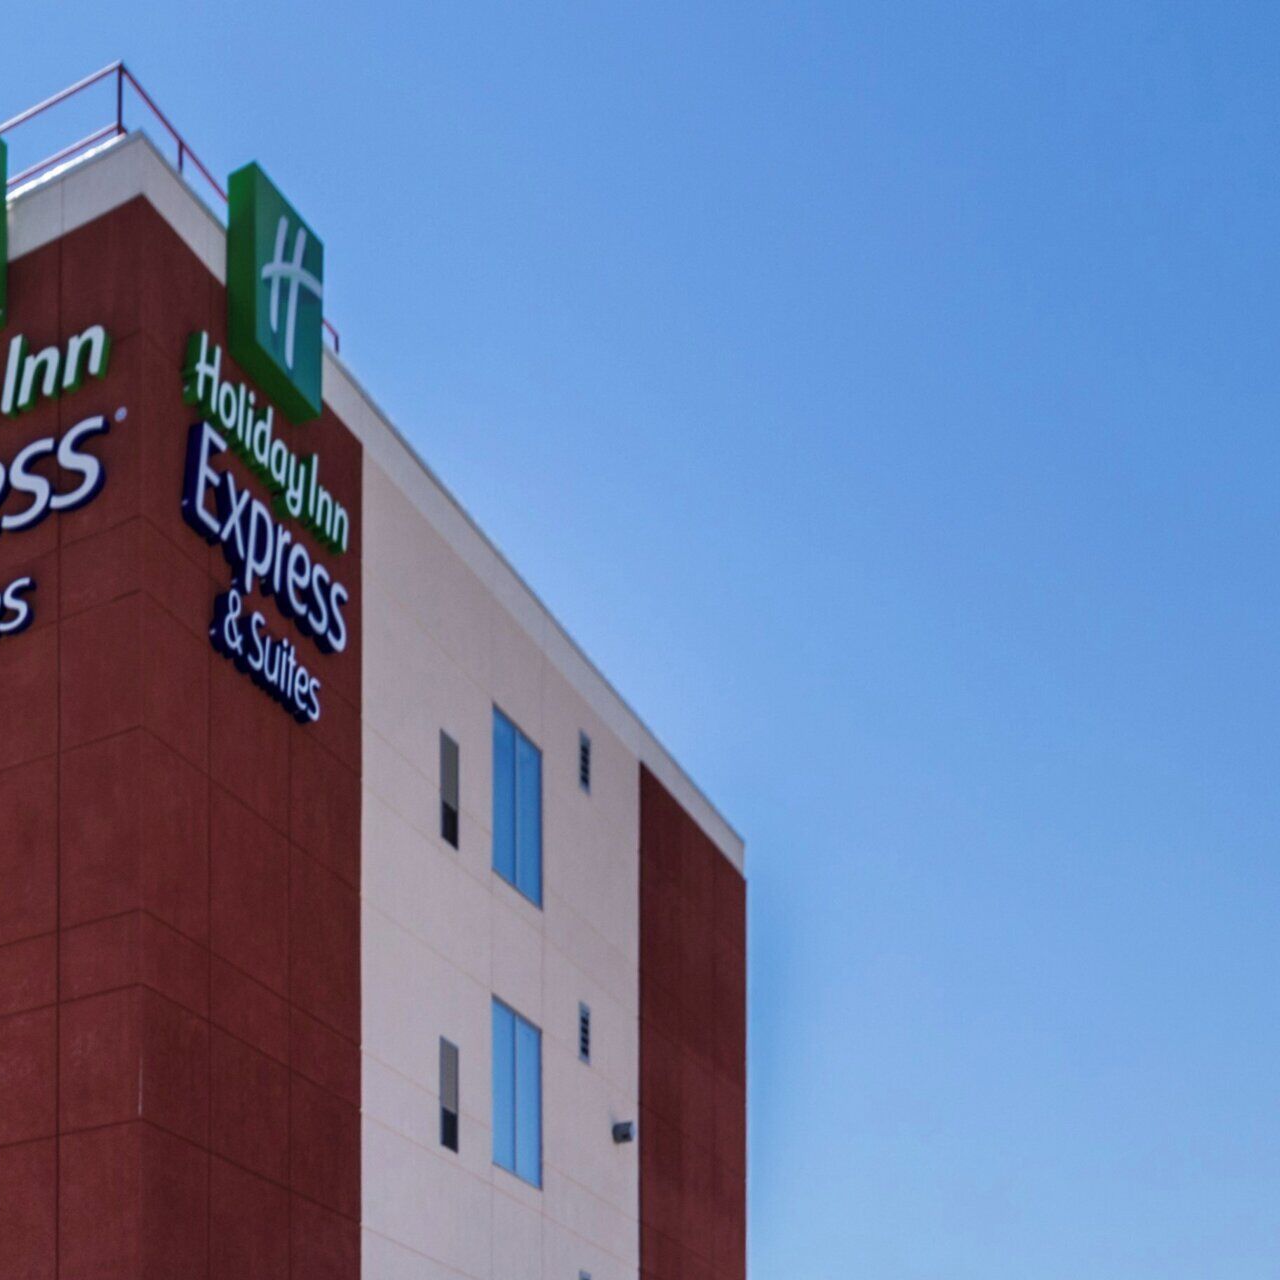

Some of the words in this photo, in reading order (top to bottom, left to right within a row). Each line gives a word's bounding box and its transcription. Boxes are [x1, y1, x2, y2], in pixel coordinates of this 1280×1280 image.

[1, 324, 108, 414] Inn
[195, 331, 306, 517] Holiday
[309, 453, 349, 551] Inn
[196, 422, 348, 652] Express
[224, 589, 242, 654] &
[248, 612, 321, 722] Suites
